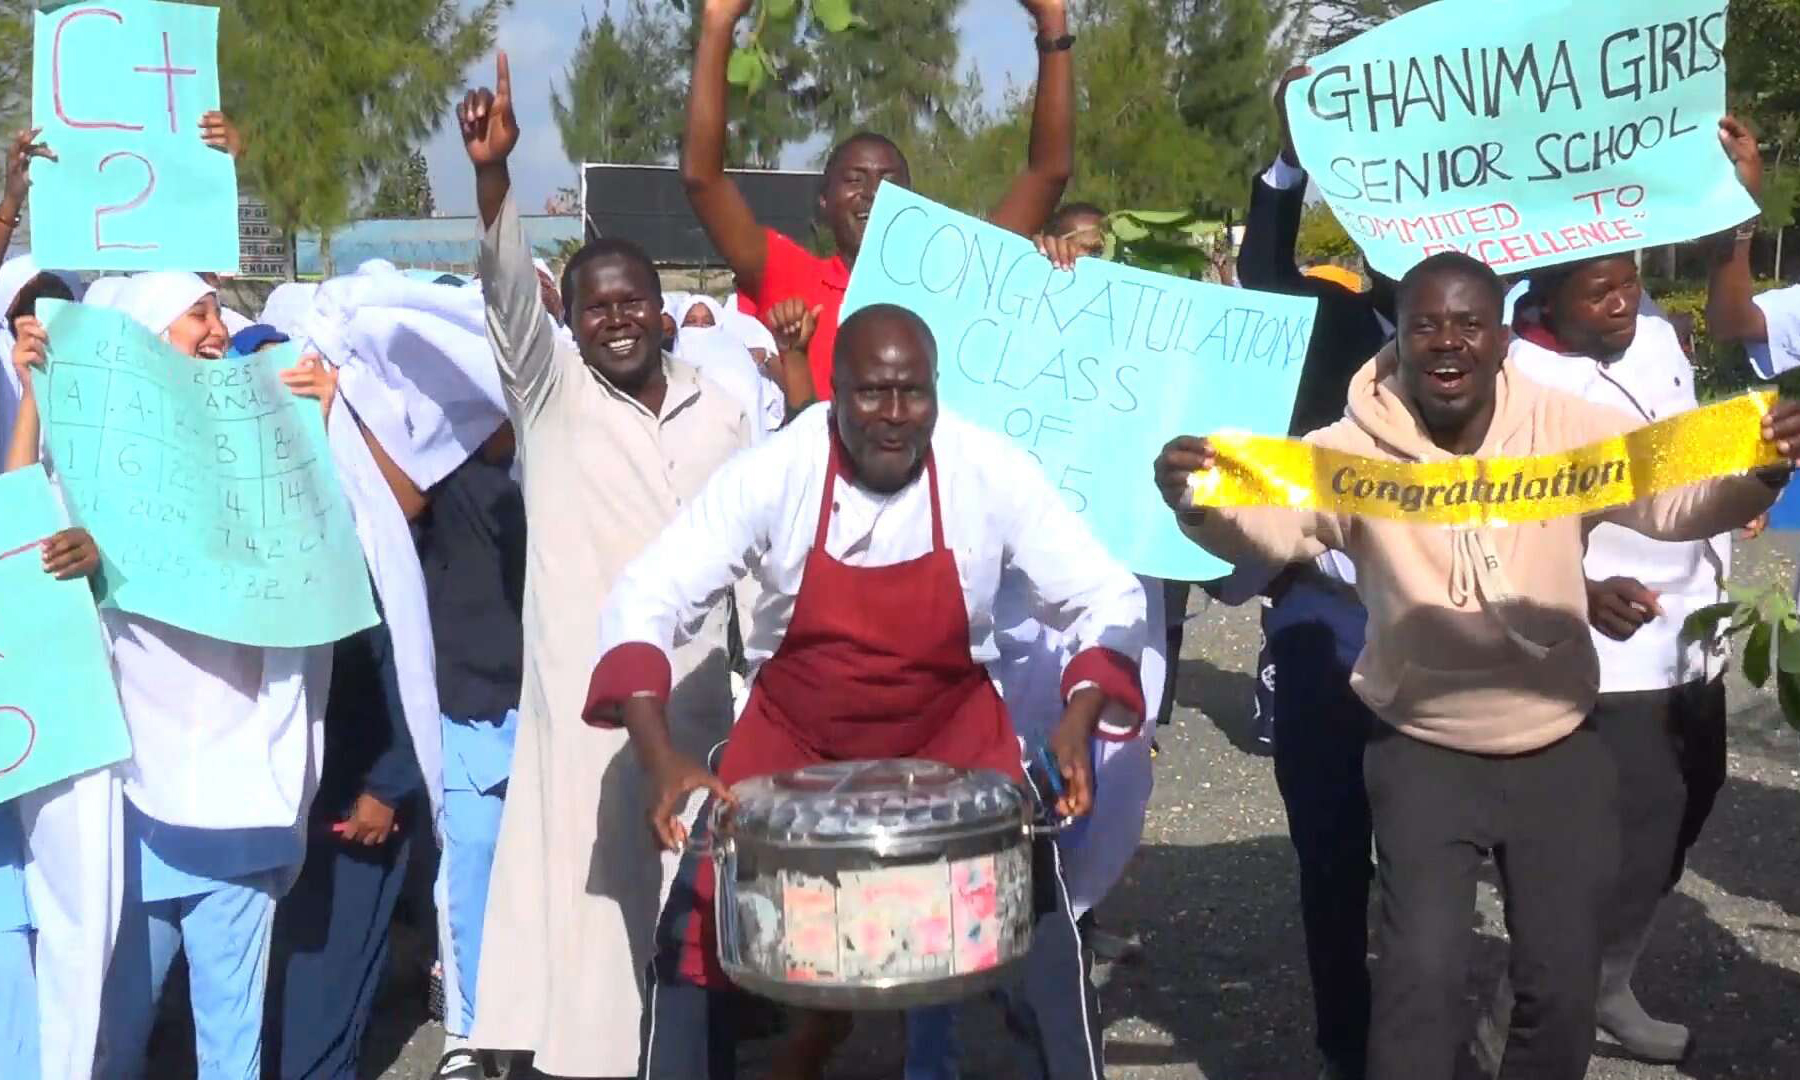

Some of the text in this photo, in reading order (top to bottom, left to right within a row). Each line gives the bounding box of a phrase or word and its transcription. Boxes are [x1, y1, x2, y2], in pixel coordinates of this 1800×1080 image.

[53, 8, 198, 133] C+
[1307, 9, 1729, 132] GHANIMA GIRLS
[96, 151, 159, 251] 2
[1319, 106, 1698, 204] SENIOR SCHOOL
[1573, 183, 1645, 216] TO
[880, 205, 1311, 369] CONGRATULATIONS
[956, 318, 1138, 412] CLASS
[214, 433, 237, 464] B
[1004, 407, 1074, 447] OF
[117, 443, 143, 477] 6
[225, 489, 249, 520] 4
[278, 480, 306, 517] 14
[1331, 458, 1626, 513] Congratulation
